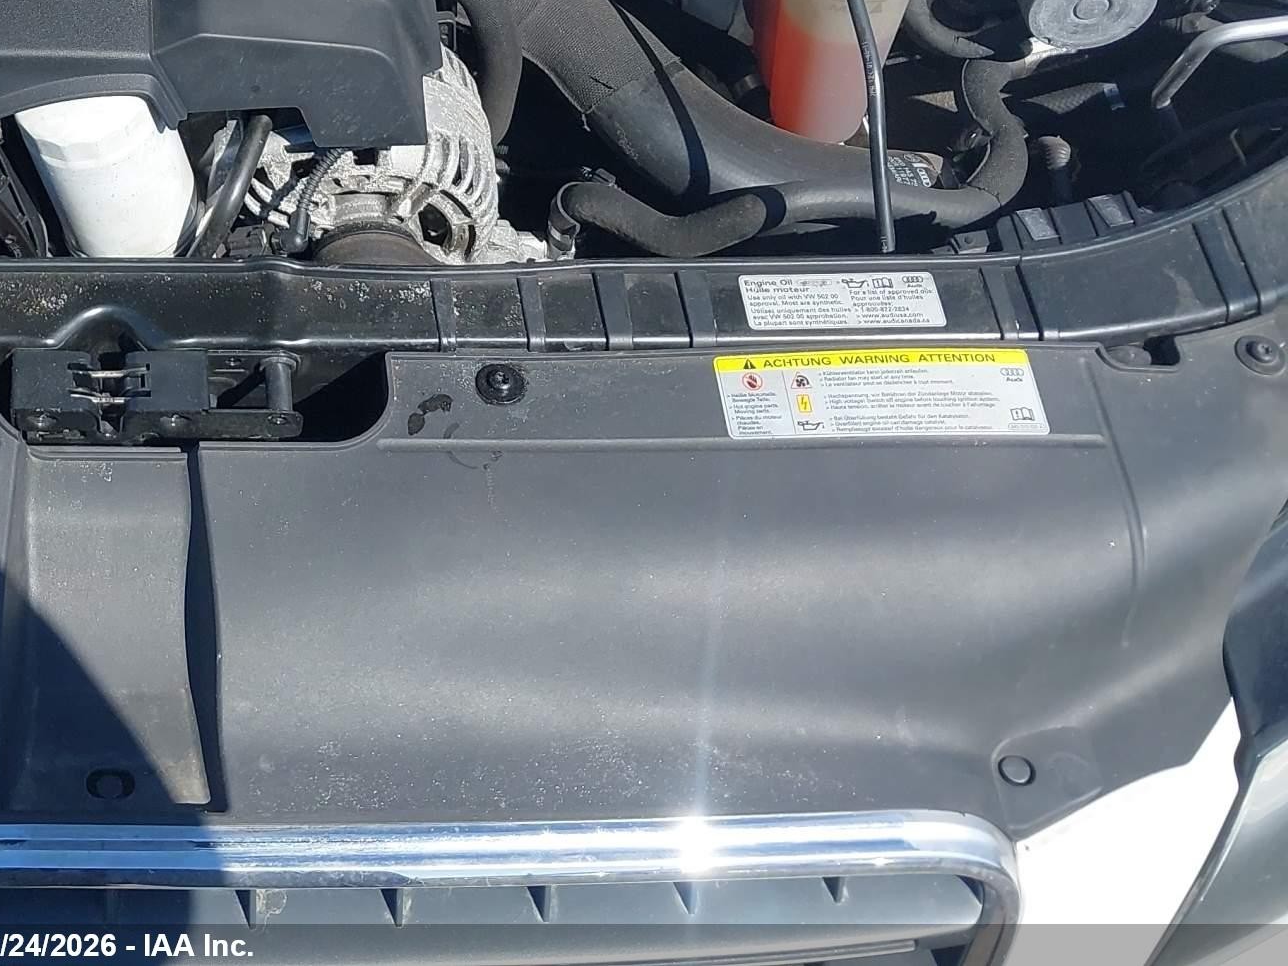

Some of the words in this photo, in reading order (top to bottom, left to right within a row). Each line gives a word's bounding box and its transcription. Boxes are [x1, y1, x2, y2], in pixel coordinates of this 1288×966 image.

[744, 280, 776, 288] Engine
[763, 357, 832, 368] ACHTUNG
[840, 354, 910, 364] WARNING
[918, 353, 996, 363] ATTENTION
